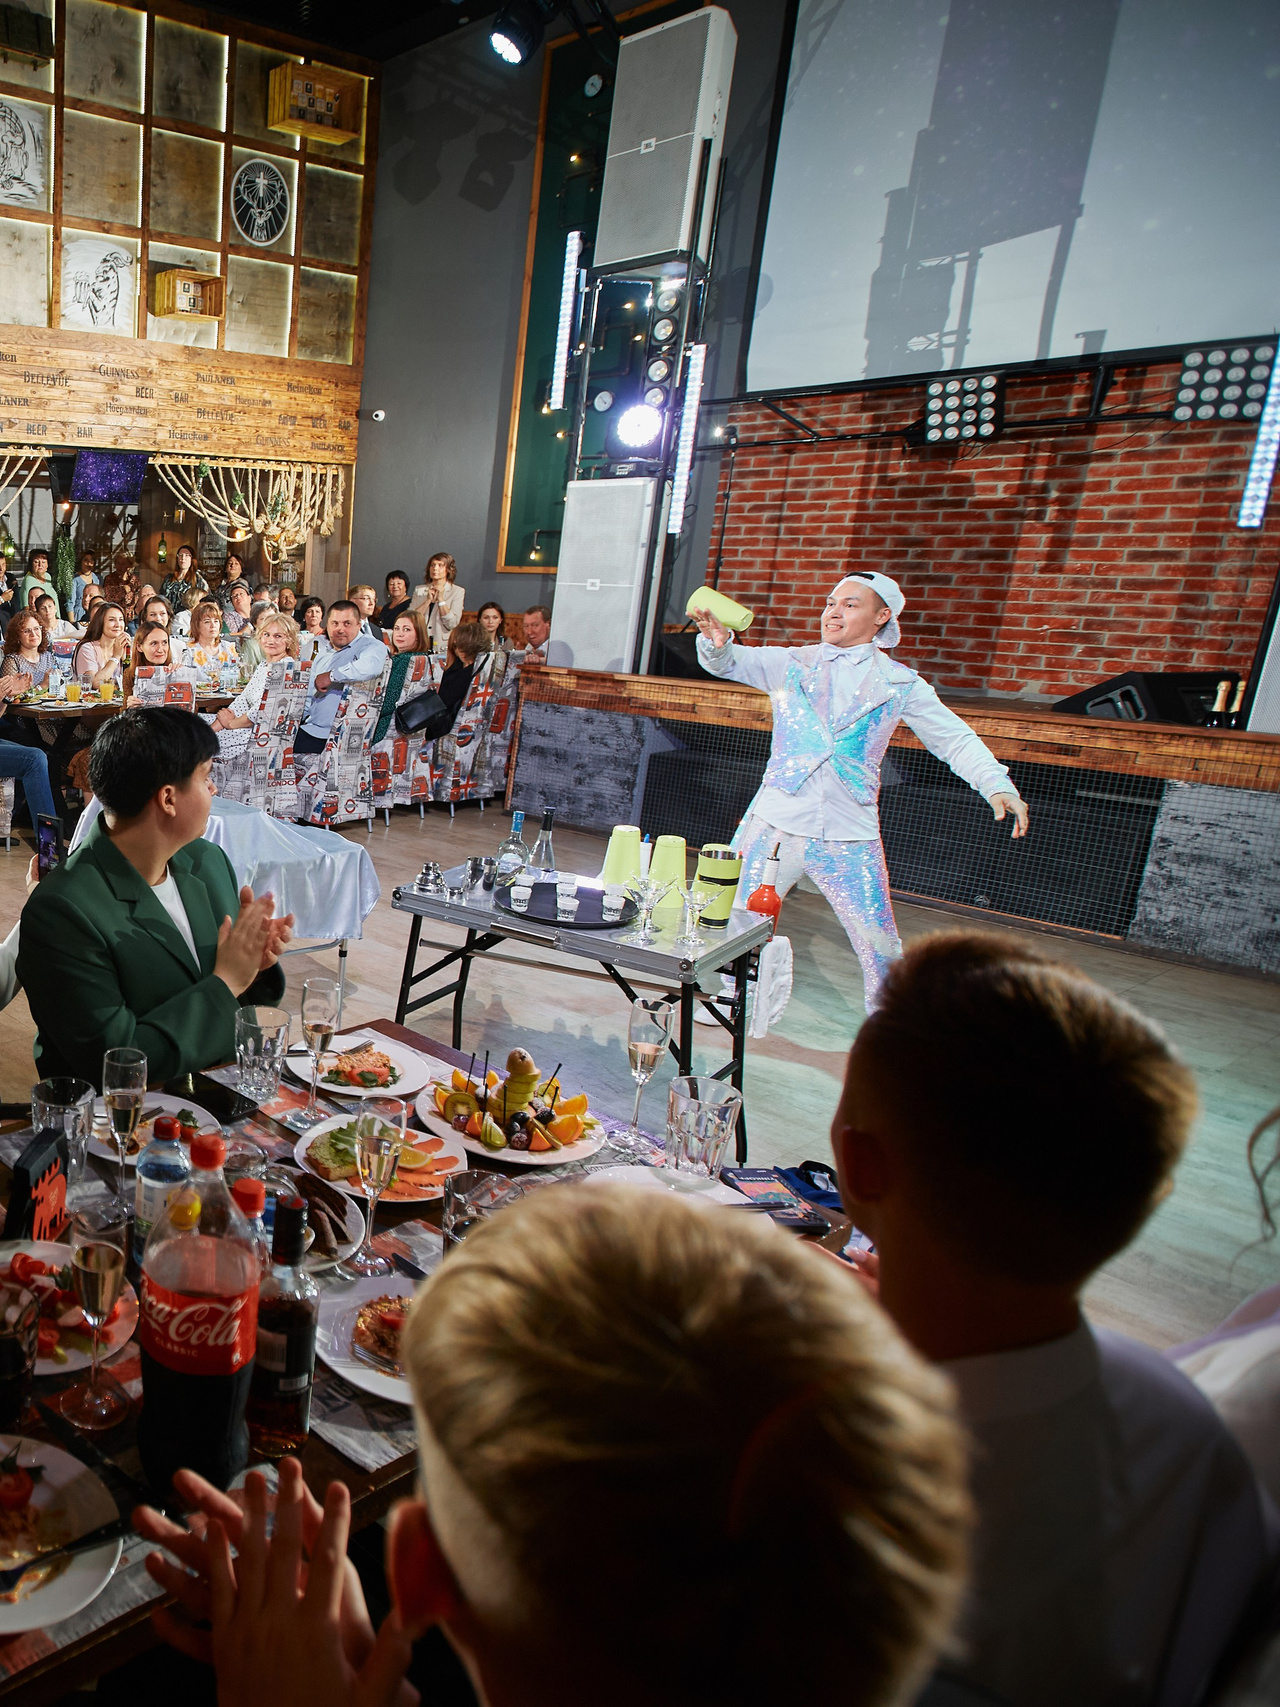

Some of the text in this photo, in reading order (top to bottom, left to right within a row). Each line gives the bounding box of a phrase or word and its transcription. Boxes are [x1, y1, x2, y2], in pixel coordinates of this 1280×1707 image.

[99, 364, 140, 380] GUINNESS
[196, 372, 236, 386] PAULANER
[136, 386, 154, 400] BEER
[174, 391, 189, 404] BAR
[26, 423, 48, 436] BEER
[77, 427, 93, 439] BAR
[154, 1337, 199, 1358] CLASSIC
